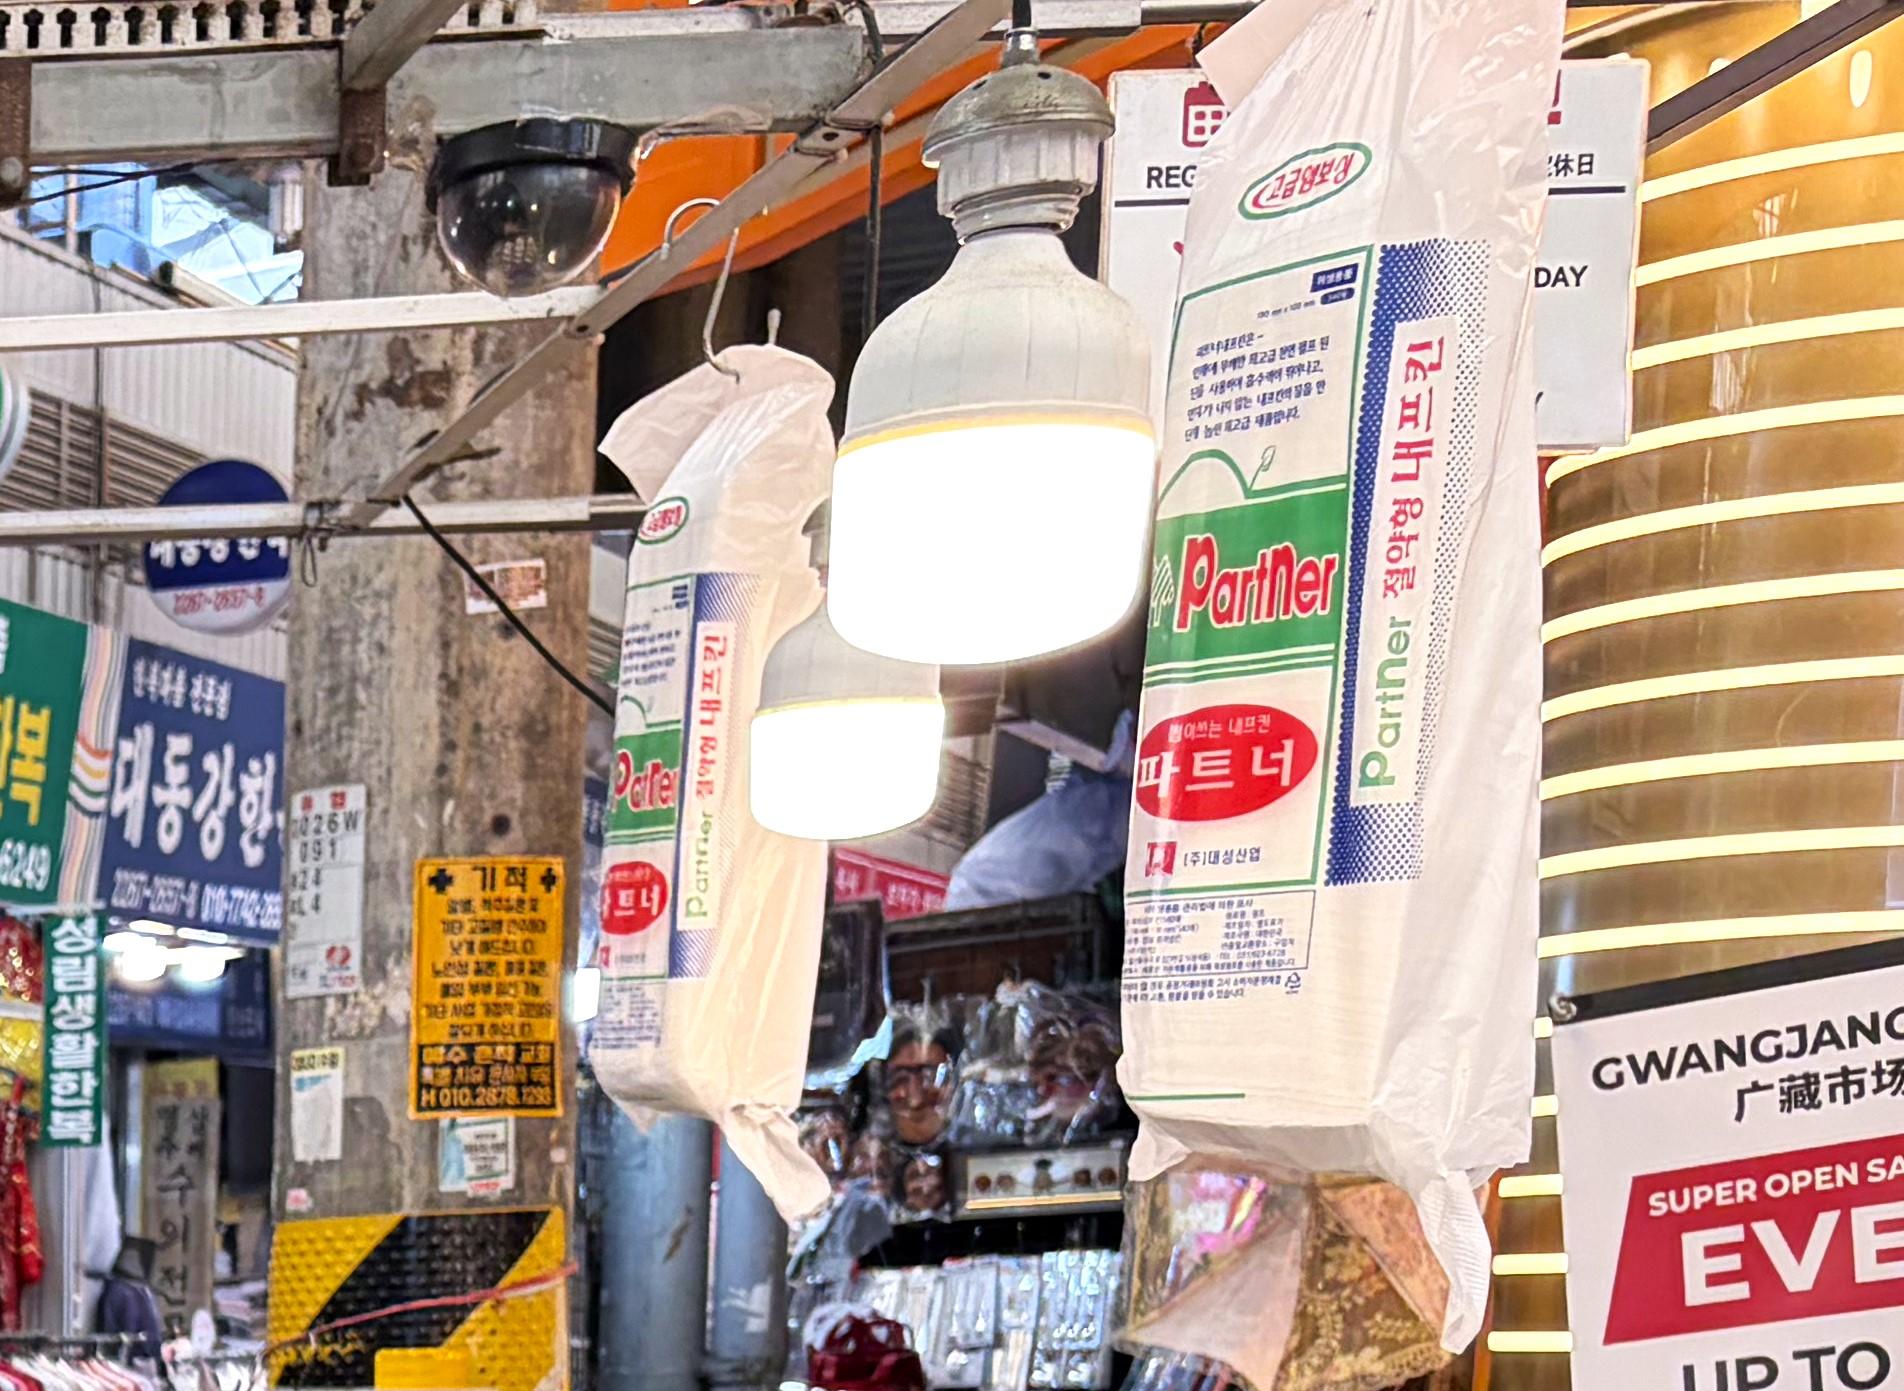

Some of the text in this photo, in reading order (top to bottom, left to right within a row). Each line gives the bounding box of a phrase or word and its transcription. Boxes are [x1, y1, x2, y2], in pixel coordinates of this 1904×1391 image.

[1547, 152, 1595, 178] 休日
[1173, 532, 1340, 634] Partner
[1357, 615, 1412, 789] Partner
[111, 720, 287, 868] 대동강한
[1138, 738, 1295, 799] 파트너
[1648, 1178, 1758, 1218] SUPER
[1763, 1162, 1860, 1200] OPEN
